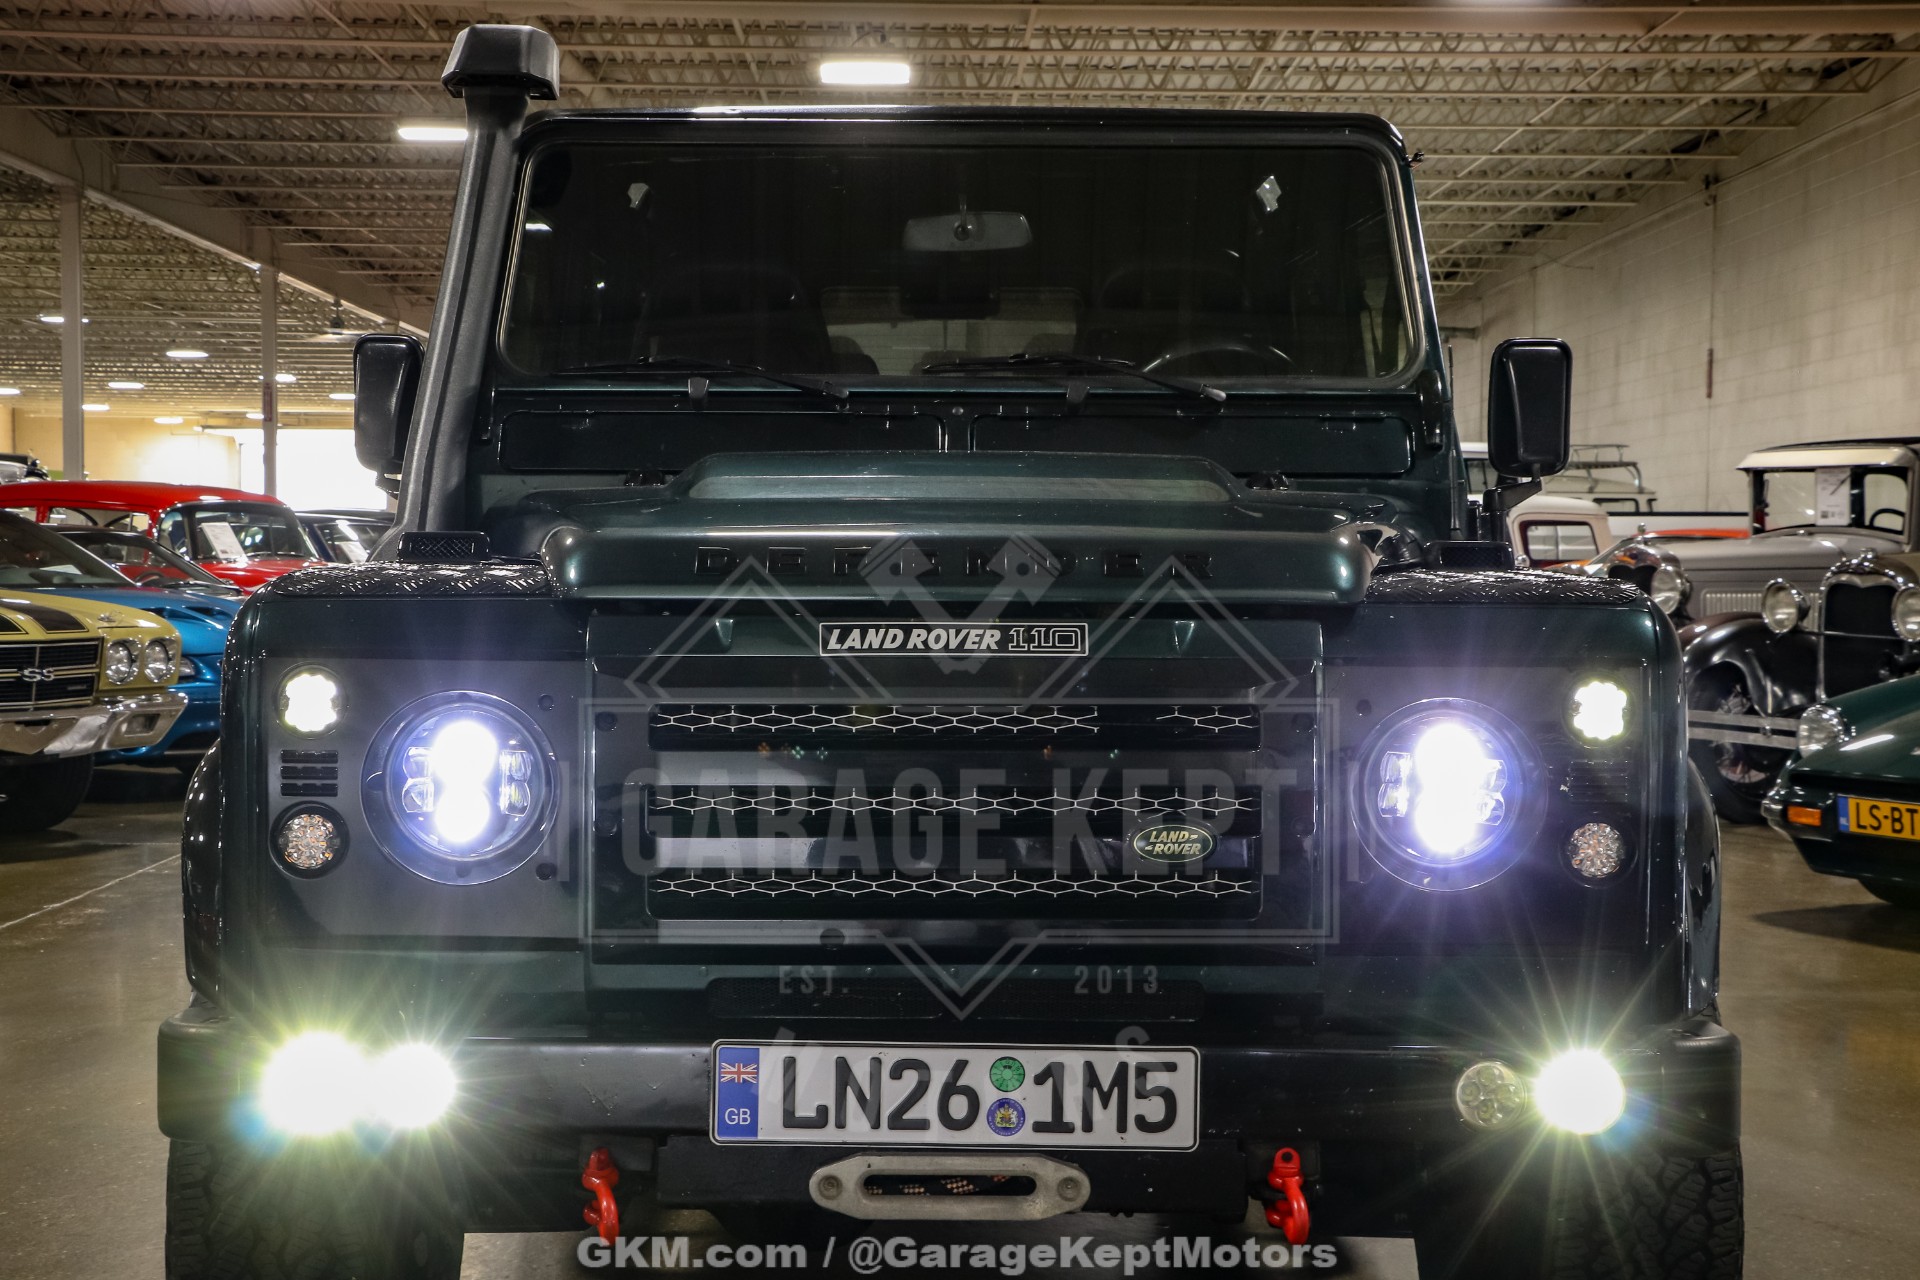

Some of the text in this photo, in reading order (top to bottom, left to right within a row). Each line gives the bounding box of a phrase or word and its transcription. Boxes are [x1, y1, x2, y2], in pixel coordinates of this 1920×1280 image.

[695, 546, 1214, 578] DEFENDER
[827, 627, 1081, 651] LAND ROVER 110
[22, 667, 55, 682] SS
[1856, 802, 1919, 836] LS-BT
[1149, 831, 1190, 843] LAND
[1153, 843, 1202, 855] ROVER
[724, 1107, 751, 1125] GB
